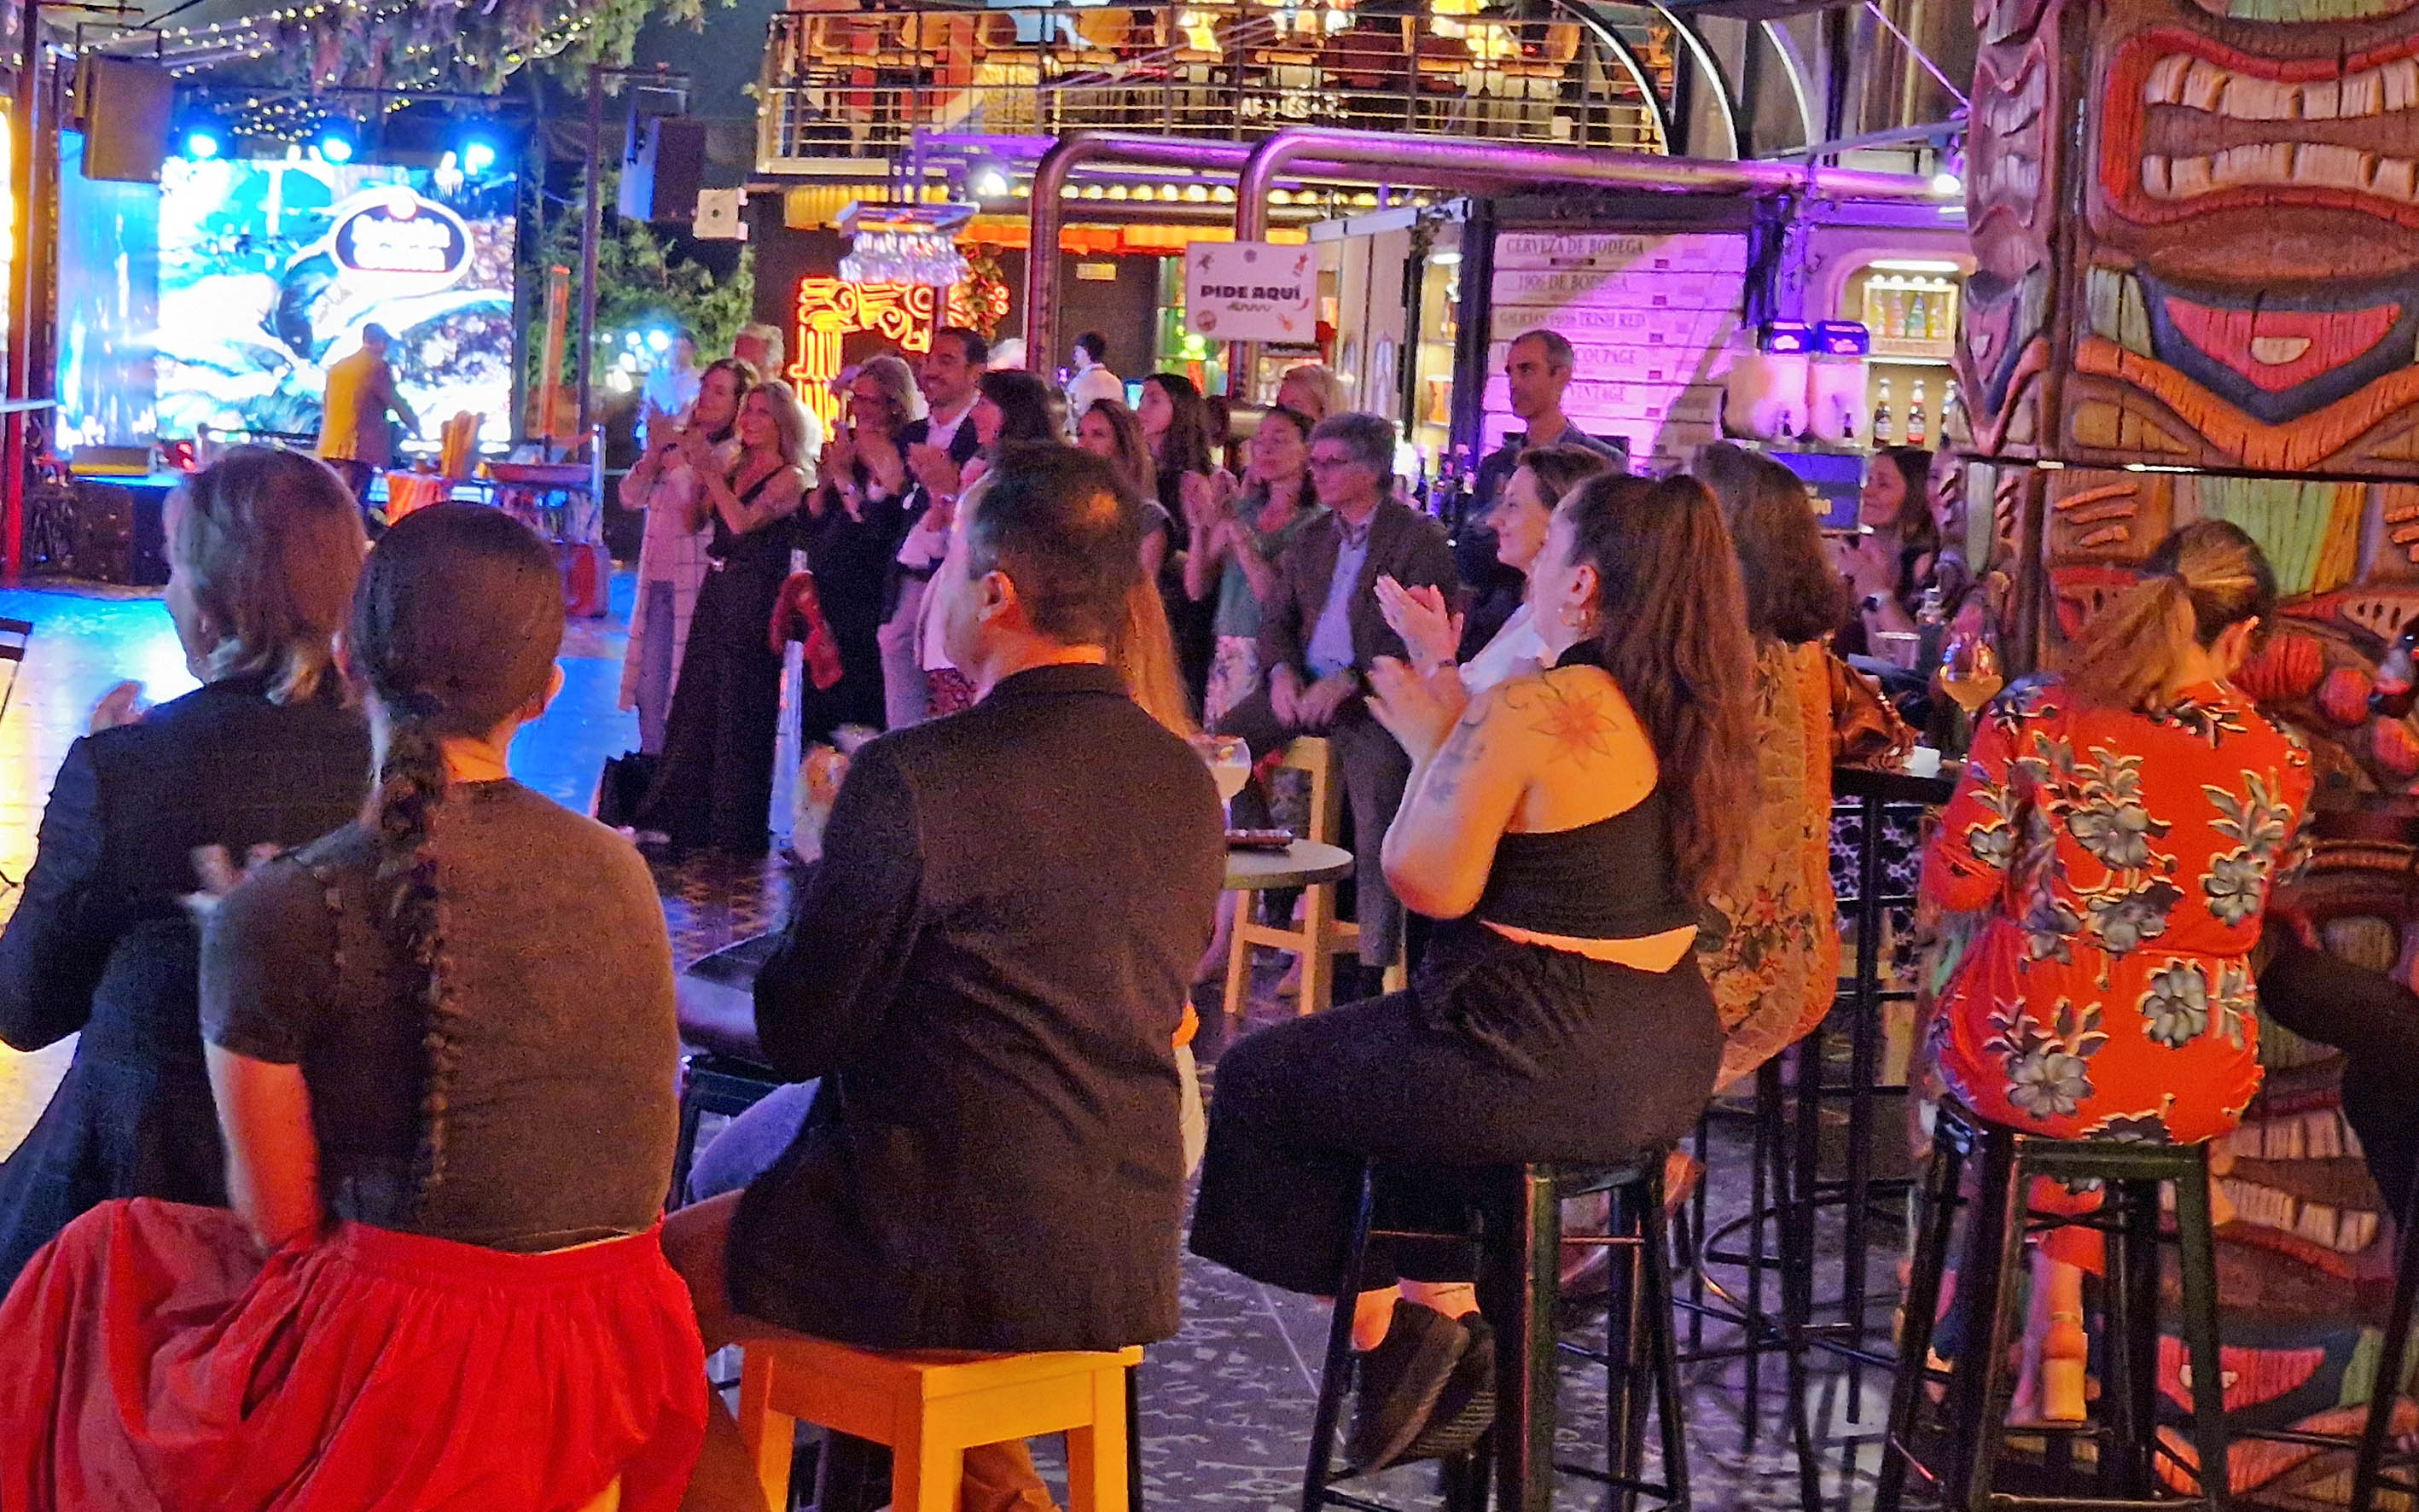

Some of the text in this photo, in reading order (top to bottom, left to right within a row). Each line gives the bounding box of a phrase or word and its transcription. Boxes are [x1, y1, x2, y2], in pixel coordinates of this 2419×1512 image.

[1507, 238, 1644, 255] CERVEZA DE BODEGA
[1201, 285, 1248, 299] PIDE
[1549, 276, 1564, 290] DE
[1572, 276, 1628, 292] BODEGA
